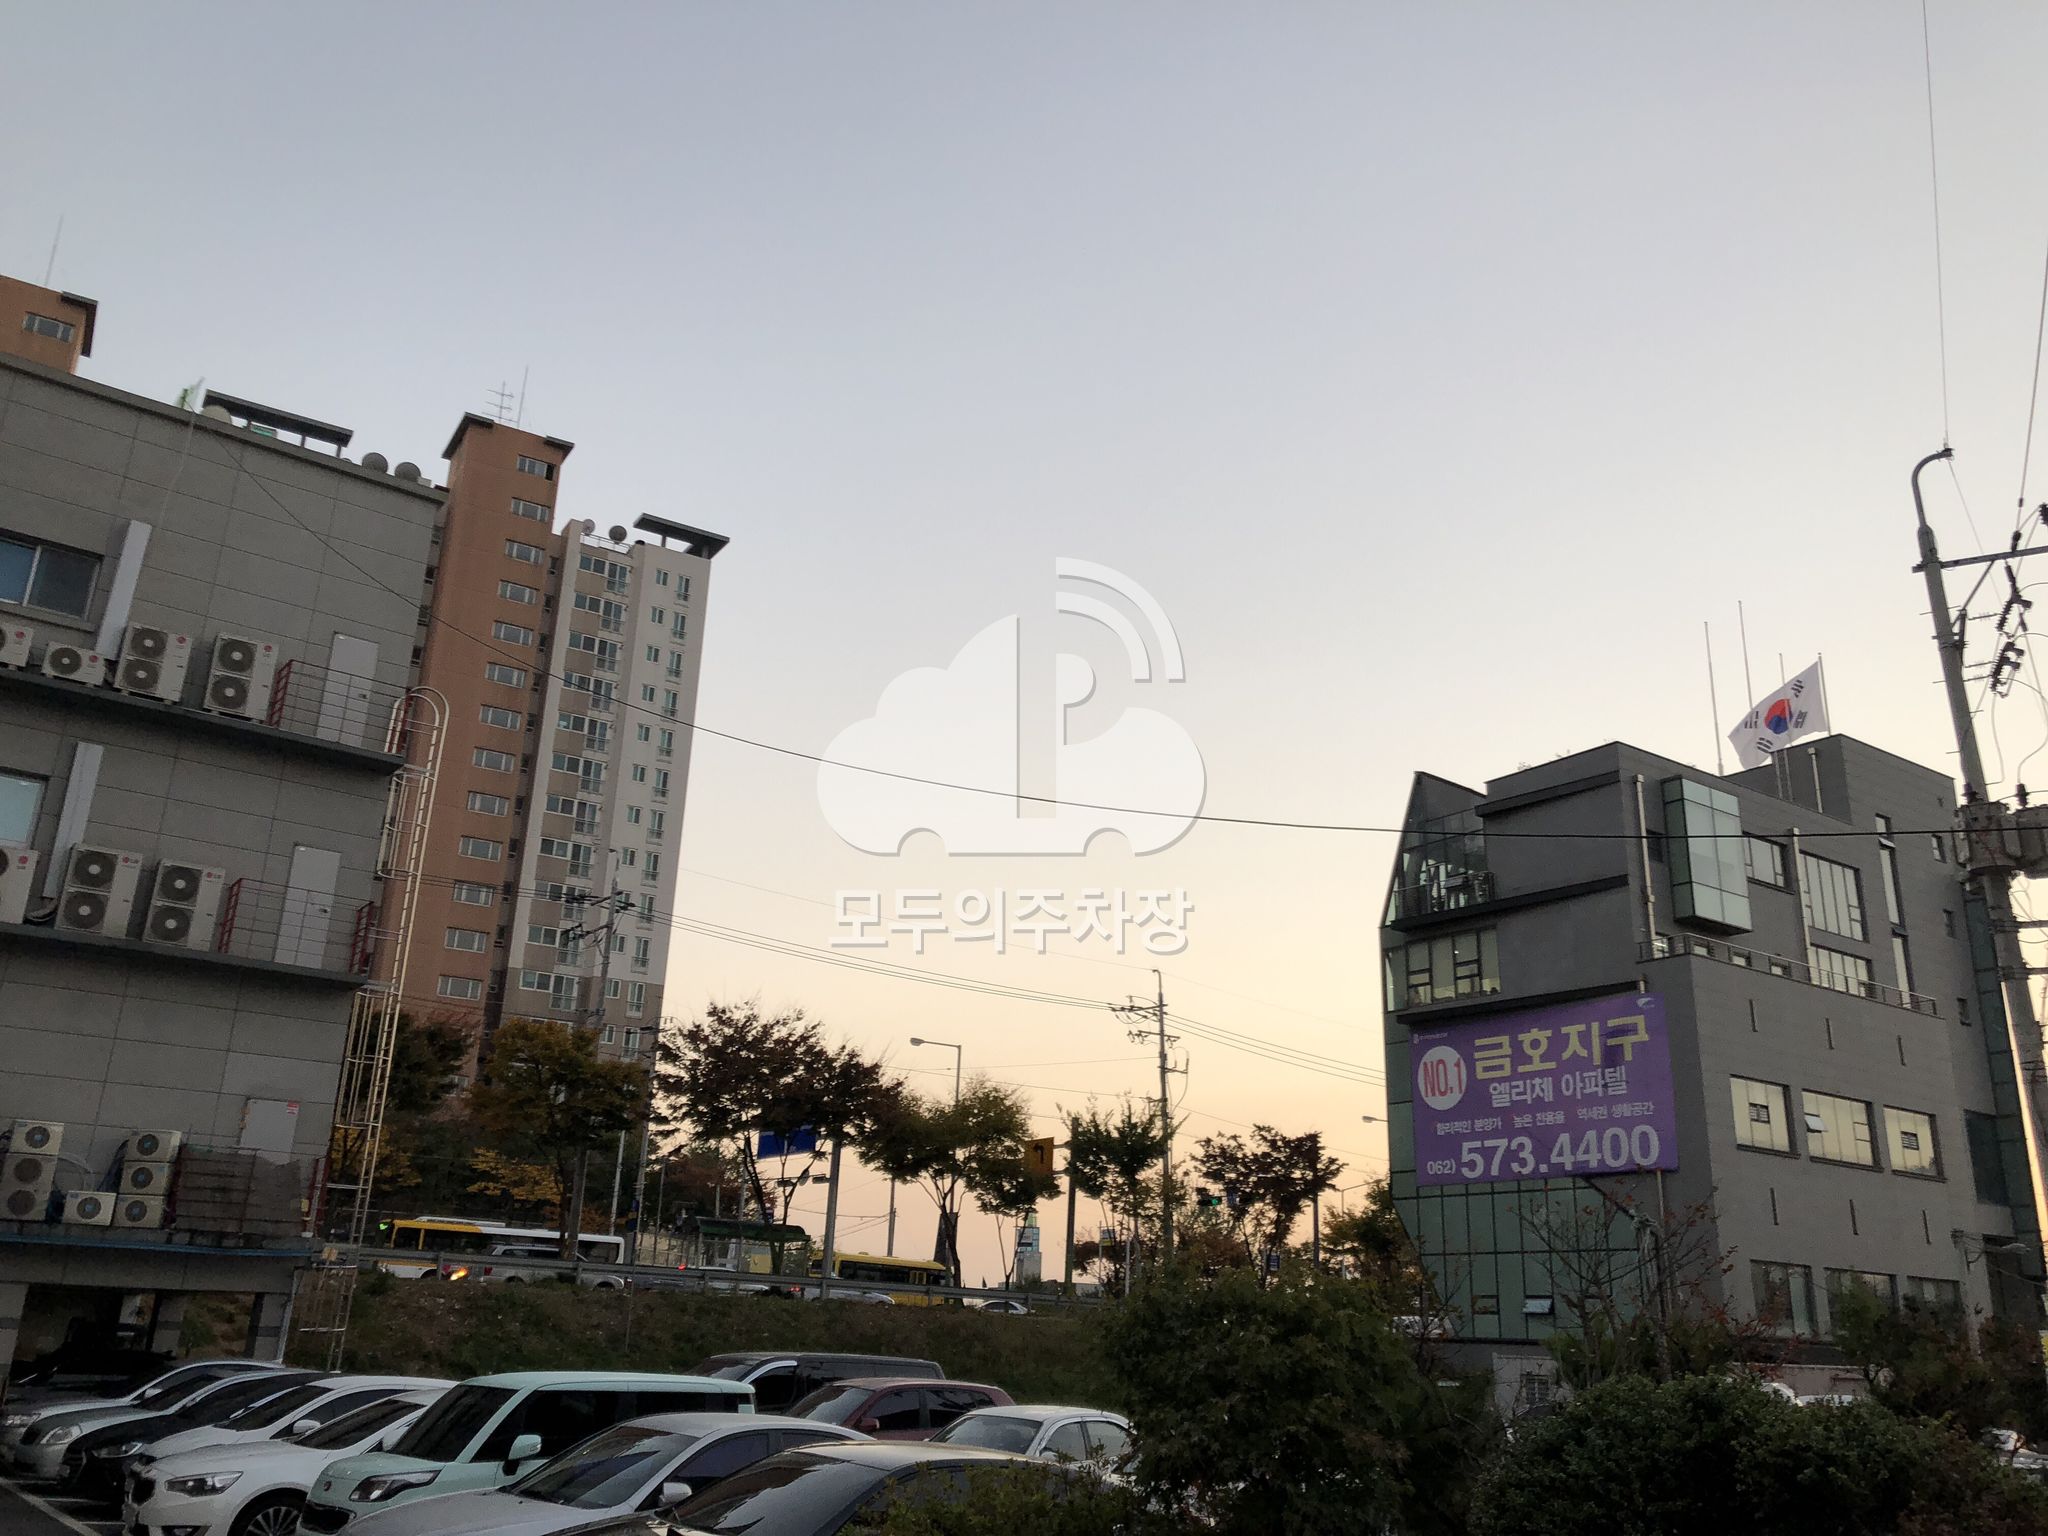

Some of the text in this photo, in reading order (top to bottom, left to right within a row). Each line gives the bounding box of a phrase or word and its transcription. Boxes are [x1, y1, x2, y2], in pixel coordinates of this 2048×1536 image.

[1473, 1015, 1649, 1080] 금호지구
[1423, 1057, 1464, 1098] NO.1
[1489, 1065, 1627, 1108] 엘리체 아파텔
[1474, 1117, 1502, 1132] 분양가
[1513, 1114, 1533, 1129] 높은
[1576, 1105, 1608, 1120] 역세권
[1612, 1101, 1655, 1118] 생활공간
[1427, 1124, 1660, 1179] 062) 573.4400
